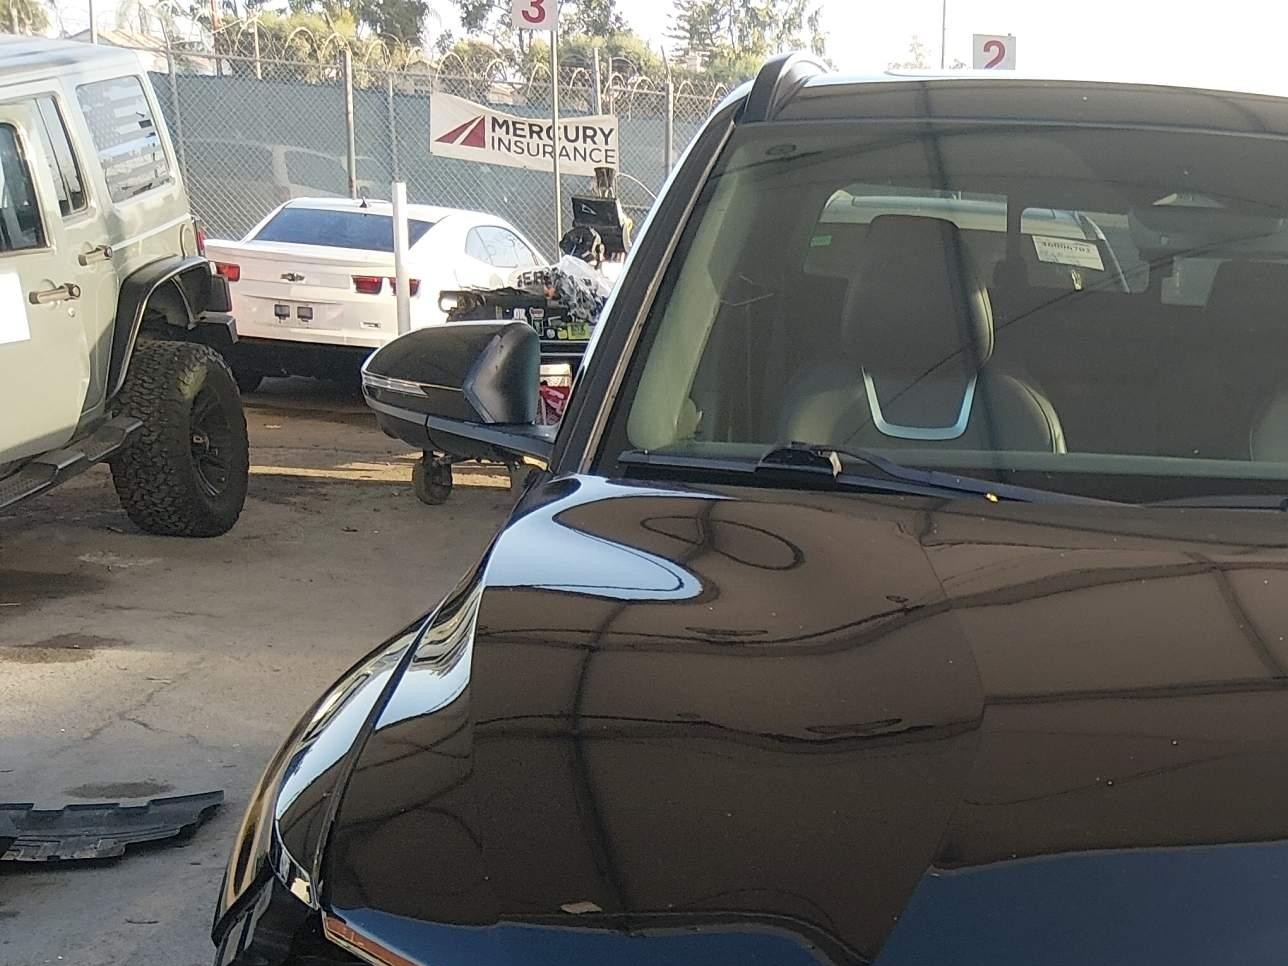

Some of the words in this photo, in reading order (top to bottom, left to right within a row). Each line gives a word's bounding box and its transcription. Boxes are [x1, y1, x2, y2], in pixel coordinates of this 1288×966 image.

[522, 0, 545, 23] 3
[984, 40, 1005, 69] 2
[491, 116, 614, 146] MERCURY
[491, 135, 616, 165] INSURANCE
